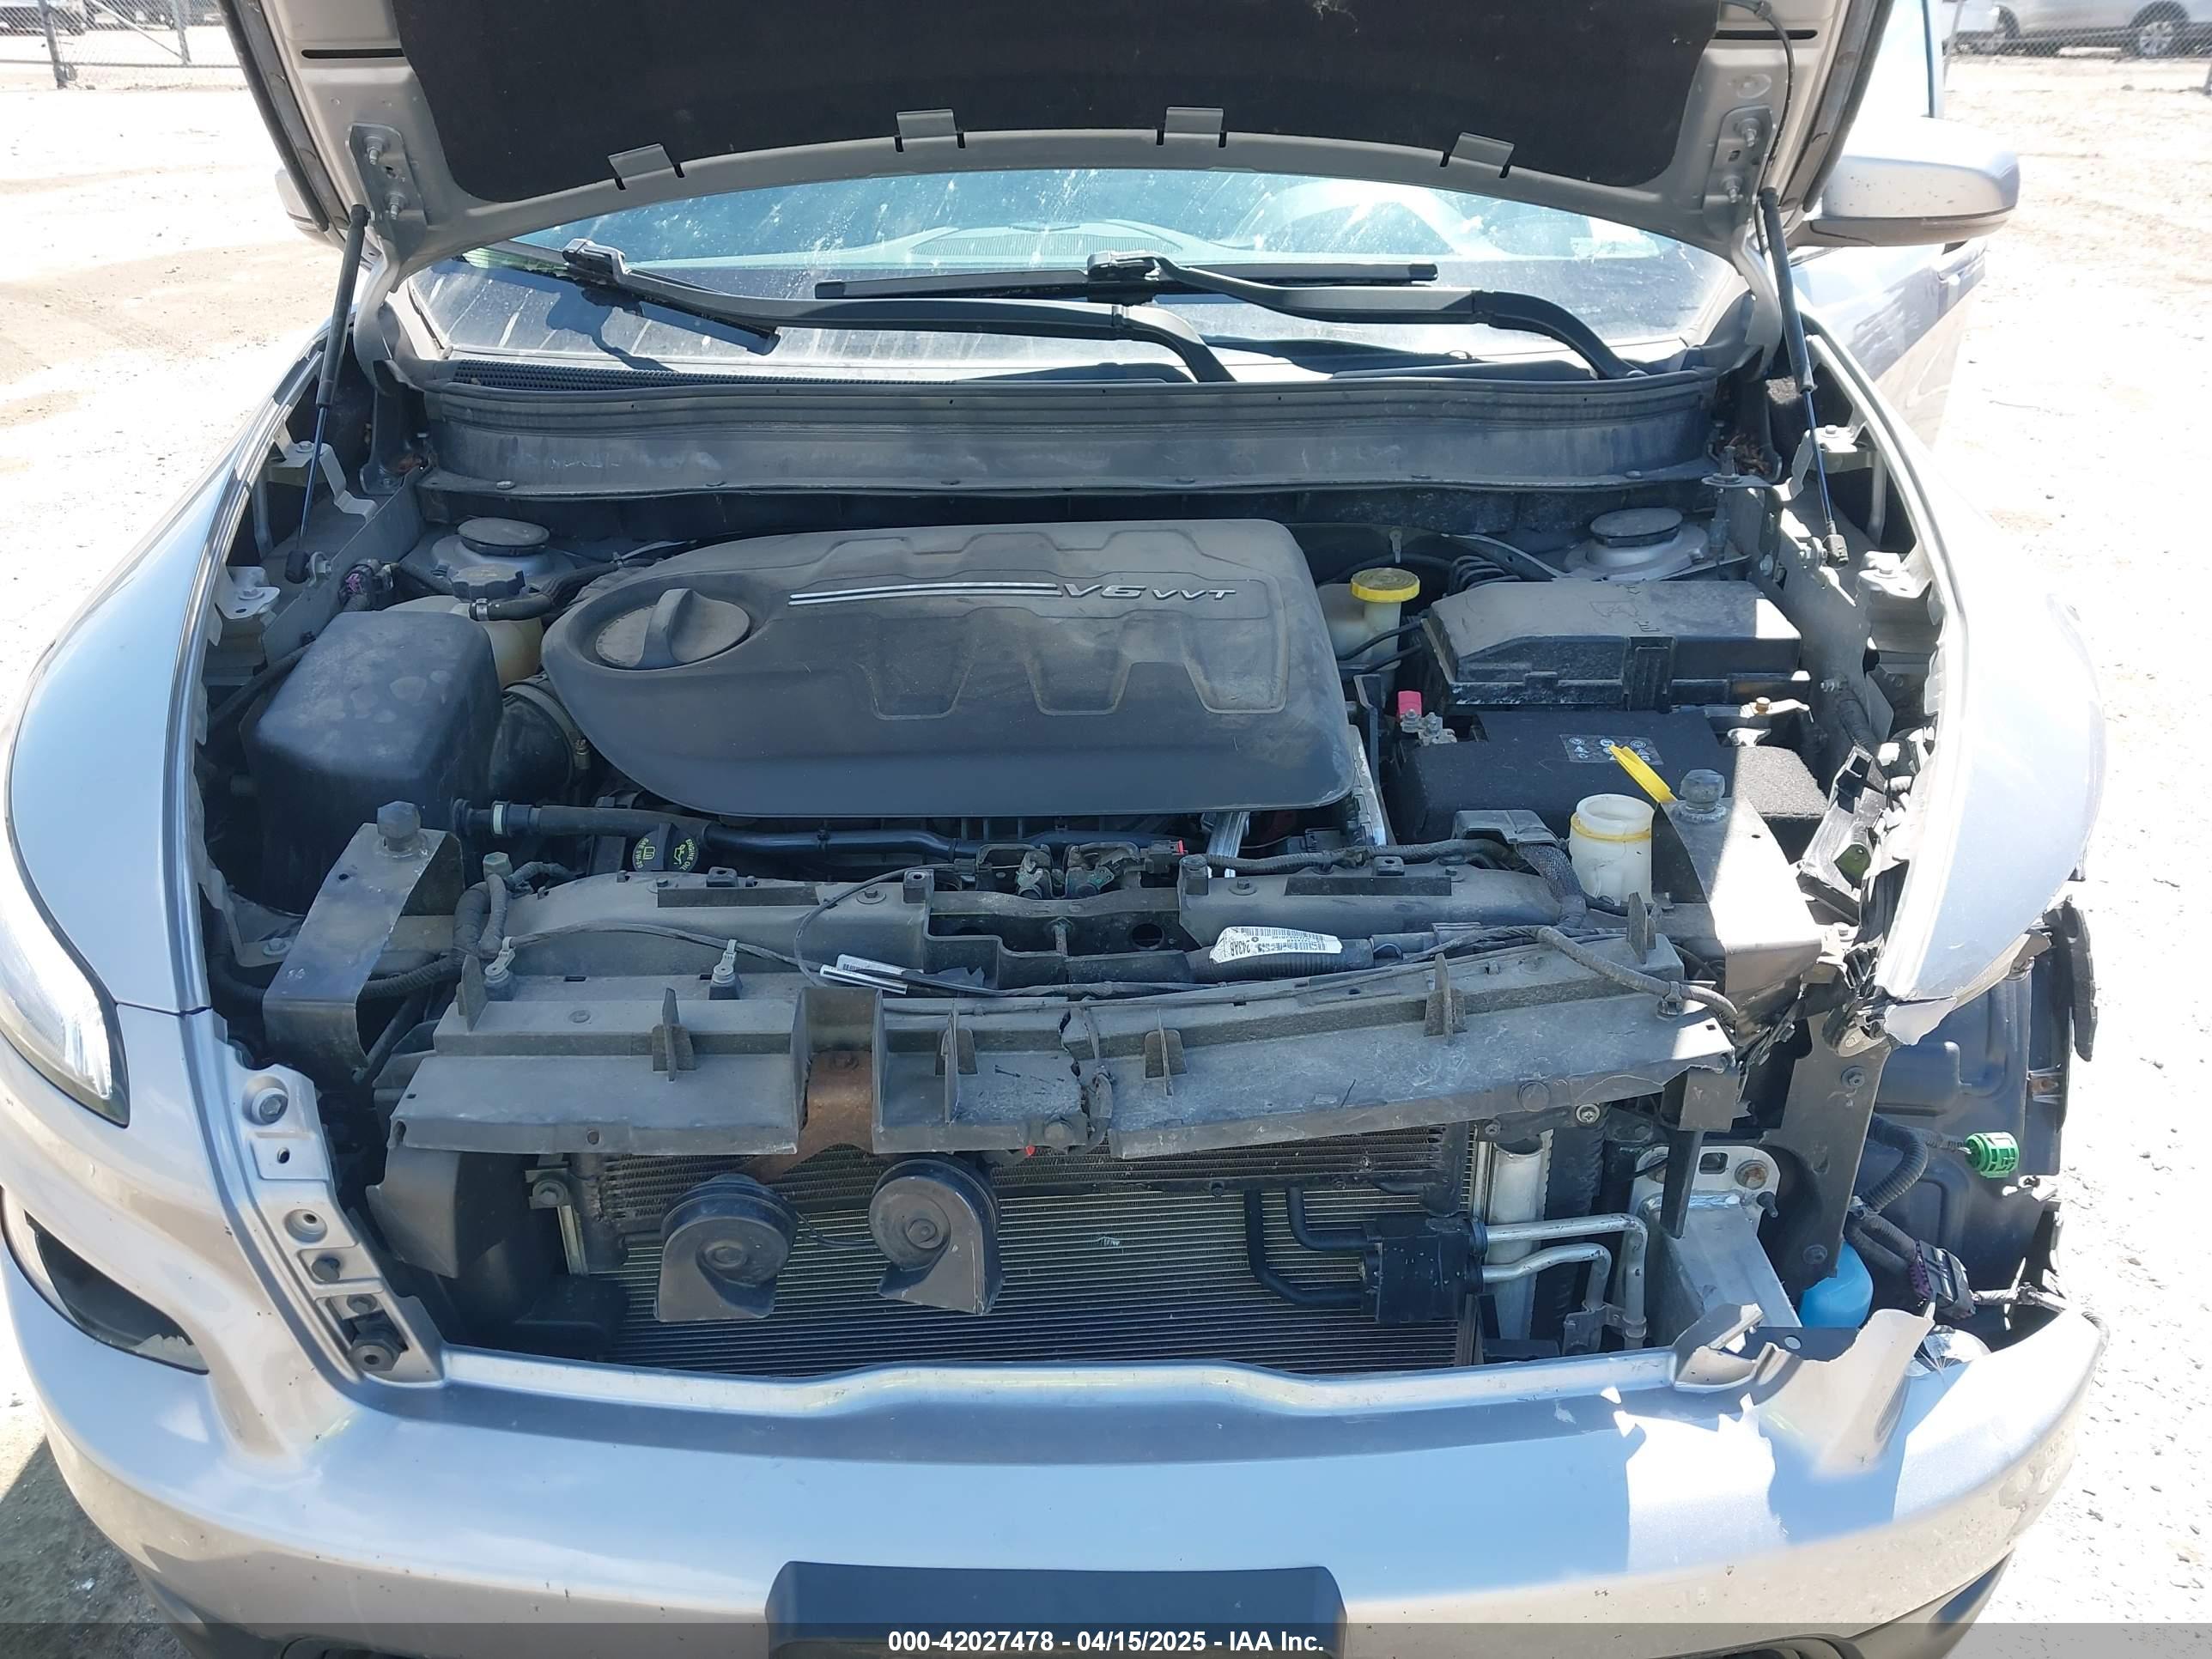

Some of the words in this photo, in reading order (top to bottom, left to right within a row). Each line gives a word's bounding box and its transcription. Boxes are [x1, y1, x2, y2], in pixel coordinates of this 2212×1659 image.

[1064, 583, 1146, 599] V6
[1152, 589, 1237, 600] VVT
[639, 837, 649, 849] SAE
[685, 838, 695, 861] ENGINE
[679, 861, 690, 871] OIL
